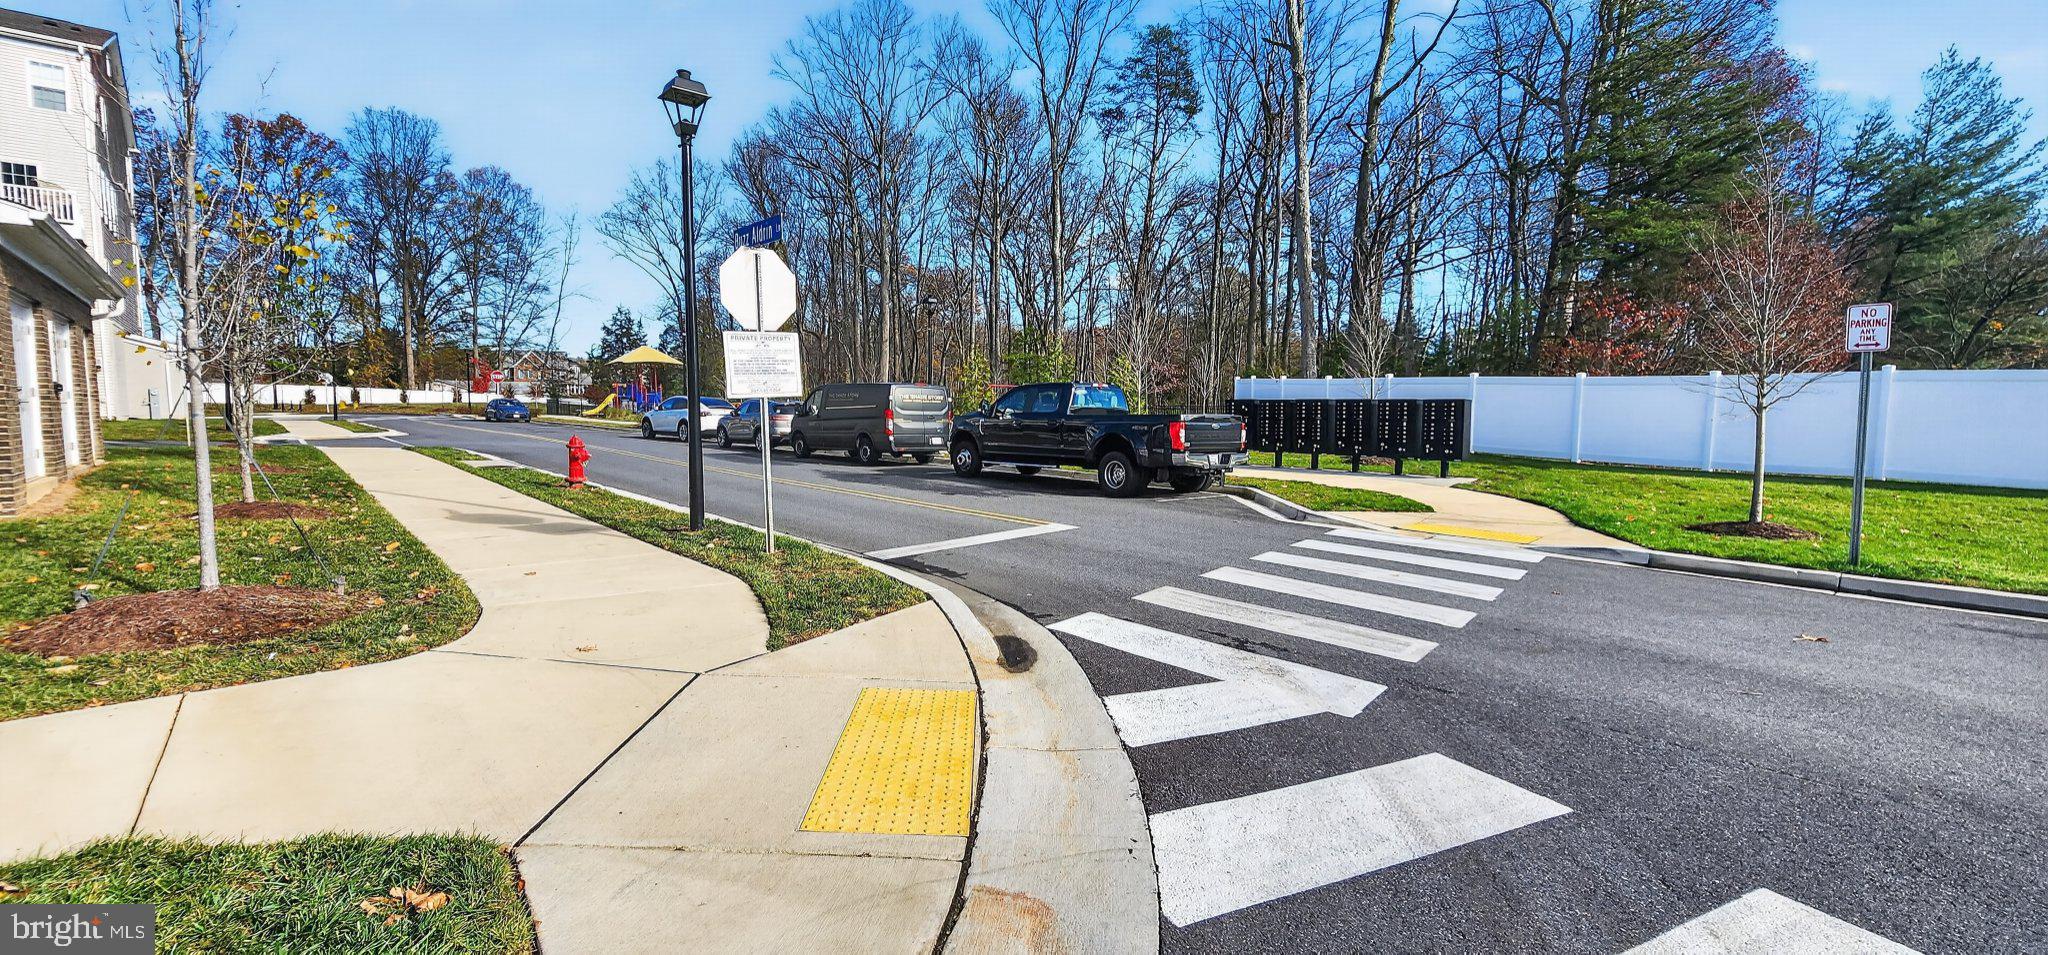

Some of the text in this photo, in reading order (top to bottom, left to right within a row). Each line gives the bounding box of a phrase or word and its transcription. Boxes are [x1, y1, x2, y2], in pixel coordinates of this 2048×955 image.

[734, 232, 750, 250] Buzz
[752, 224, 772, 245] Aldrin
[1861, 308, 1877, 318] NO
[1850, 318, 1888, 328] PARKING
